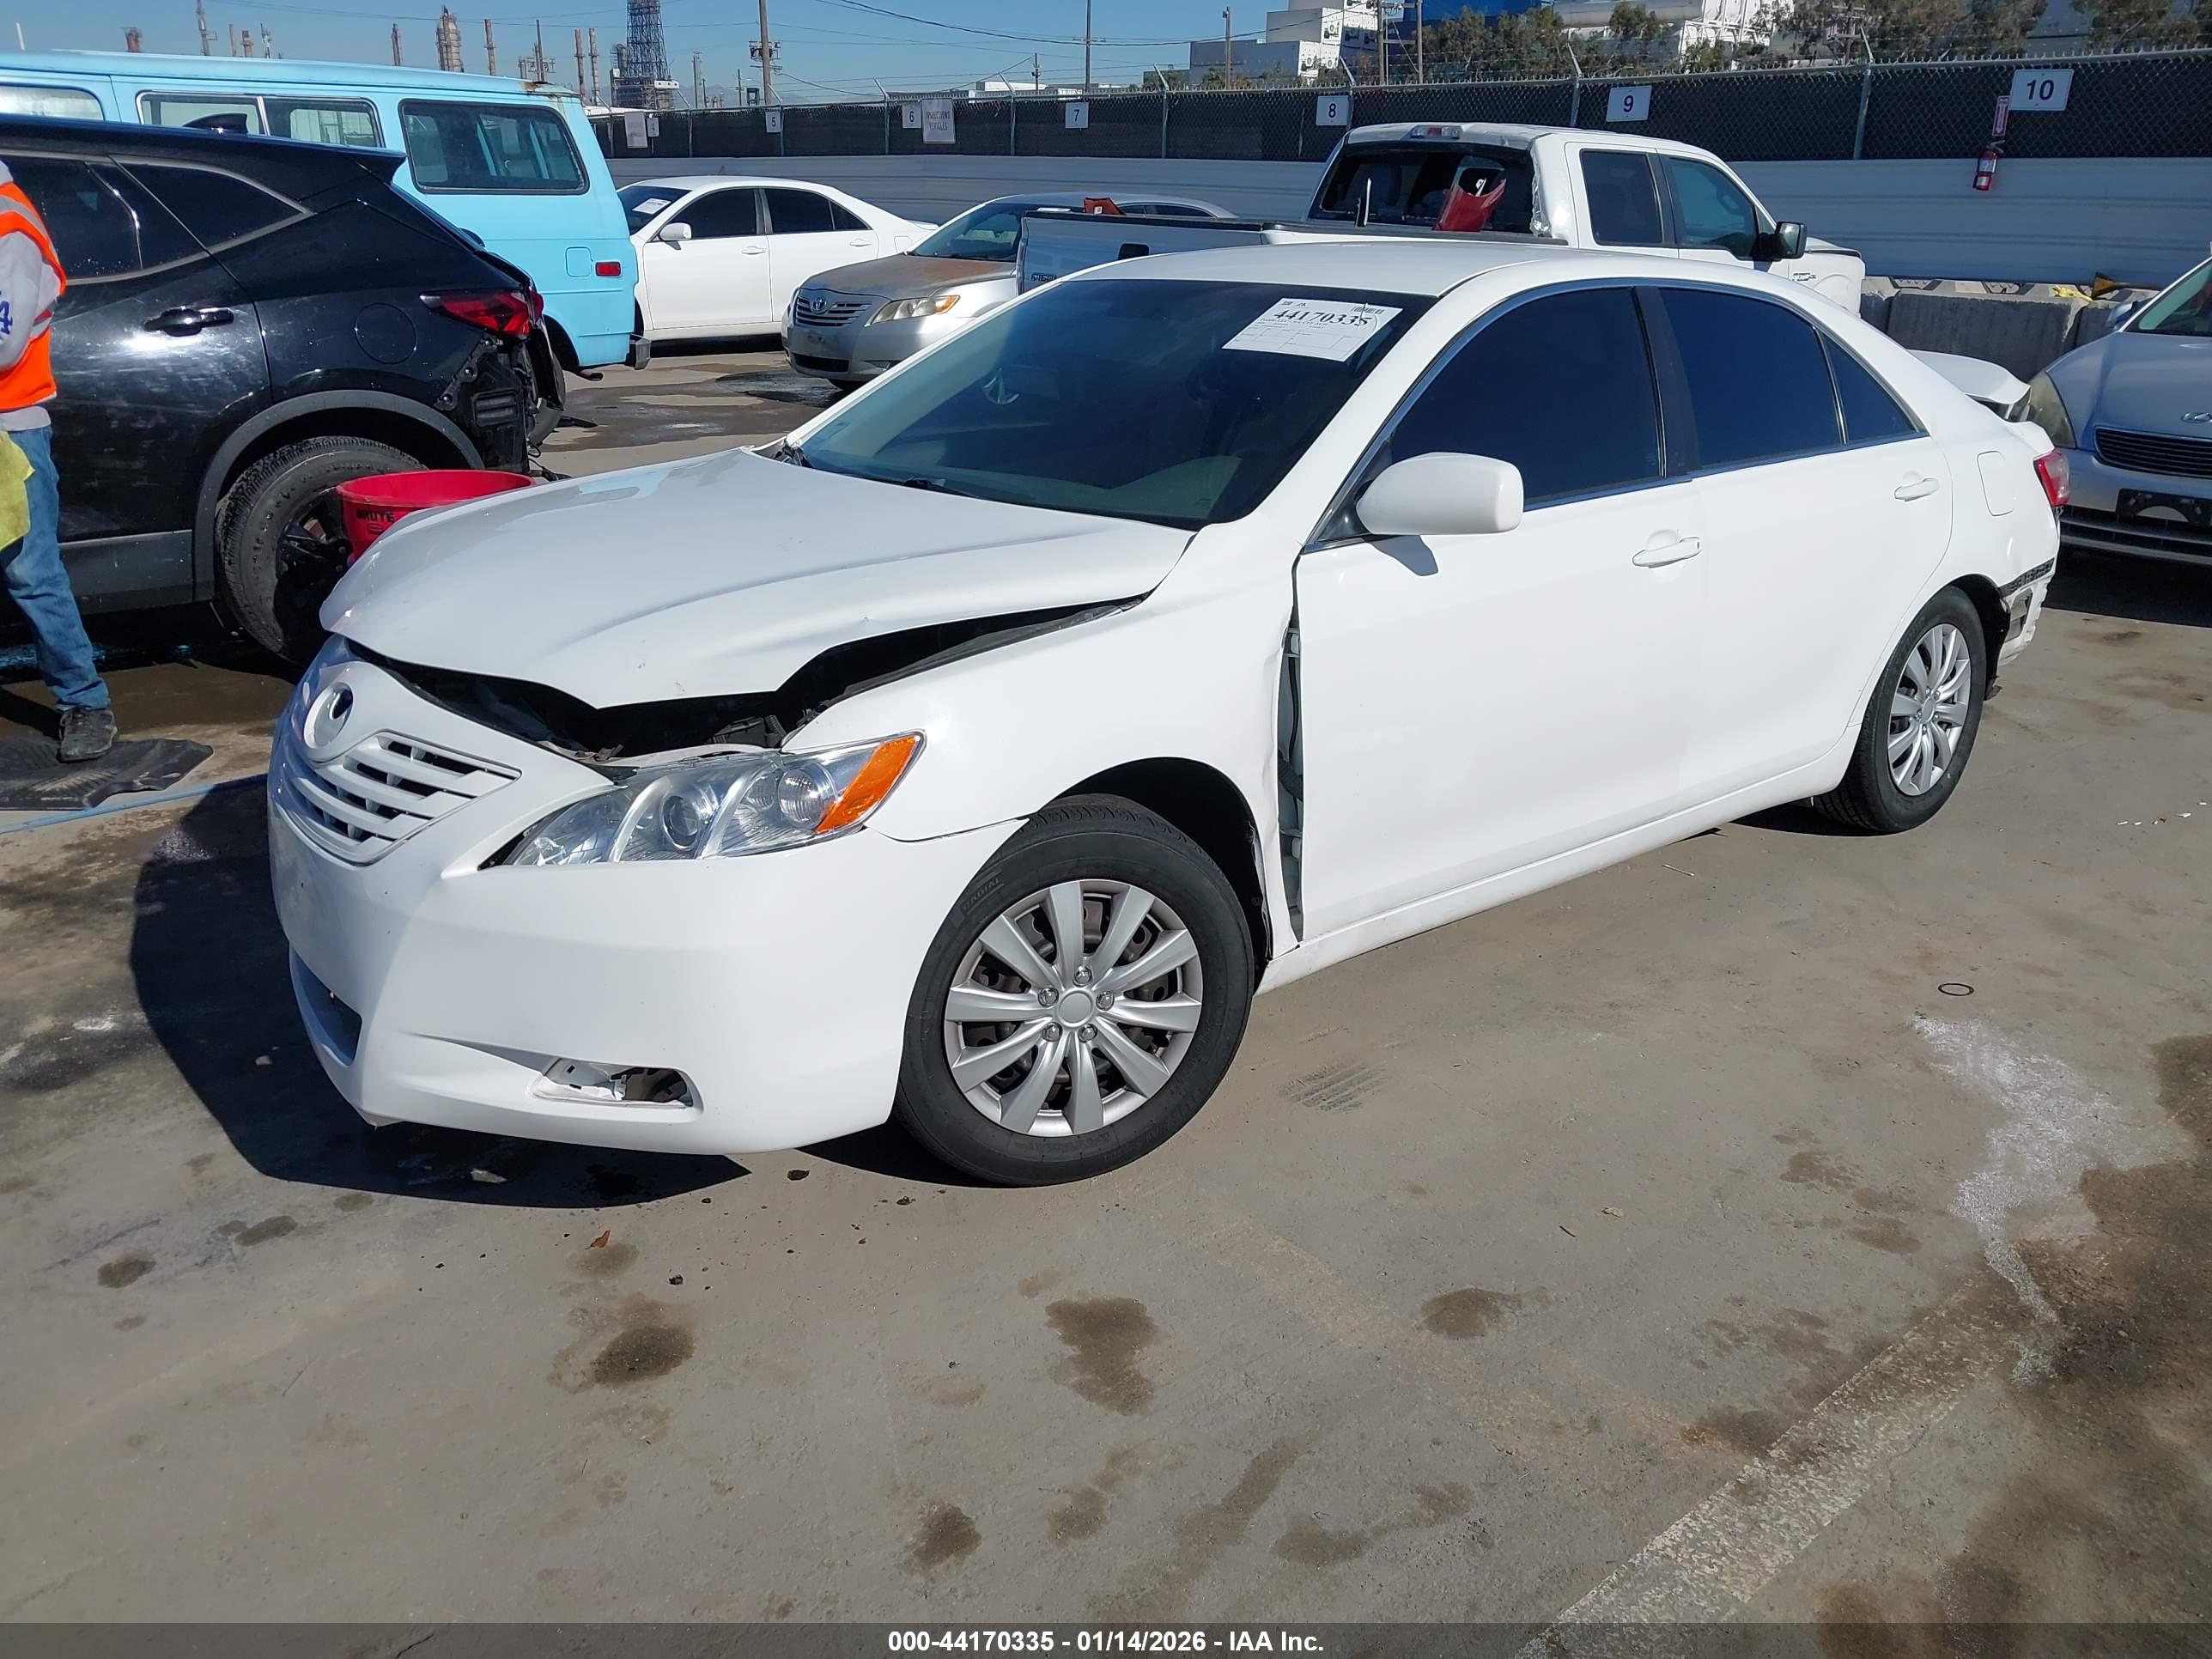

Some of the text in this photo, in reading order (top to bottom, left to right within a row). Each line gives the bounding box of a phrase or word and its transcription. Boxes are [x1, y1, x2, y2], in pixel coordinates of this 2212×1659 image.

[2027, 79, 2055, 100] 10
[1328, 103, 1336, 118] 8
[1624, 94, 1634, 112] 9
[771, 116, 776, 127] 5
[908, 110, 915, 123] 6
[1073, 109, 1080, 122] 7
[1273, 309, 1373, 327] 44170335
[356, 508, 394, 523] BRUTE
